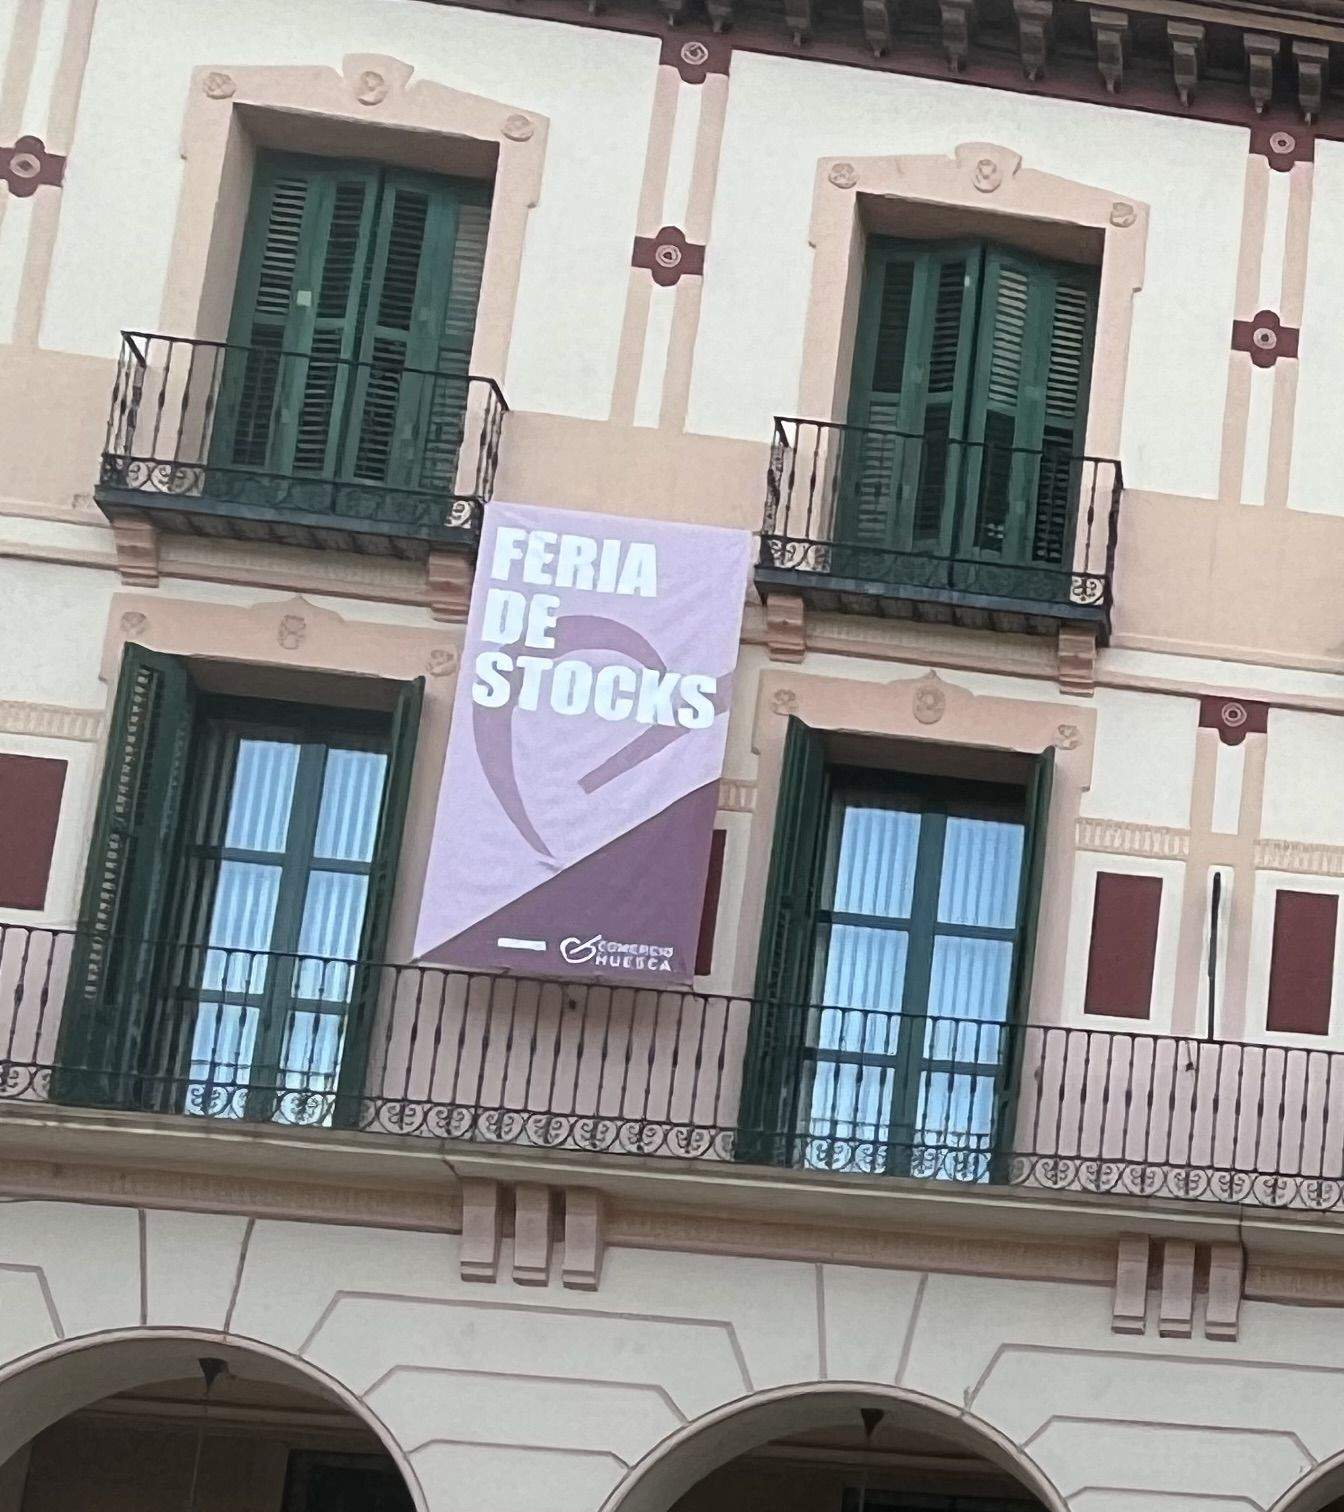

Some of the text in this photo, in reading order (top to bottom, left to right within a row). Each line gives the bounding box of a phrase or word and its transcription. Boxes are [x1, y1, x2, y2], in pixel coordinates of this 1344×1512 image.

[491, 526, 658, 598] FERIA
[481, 587, 561, 649] DE
[472, 651, 718, 730] STOCKS
